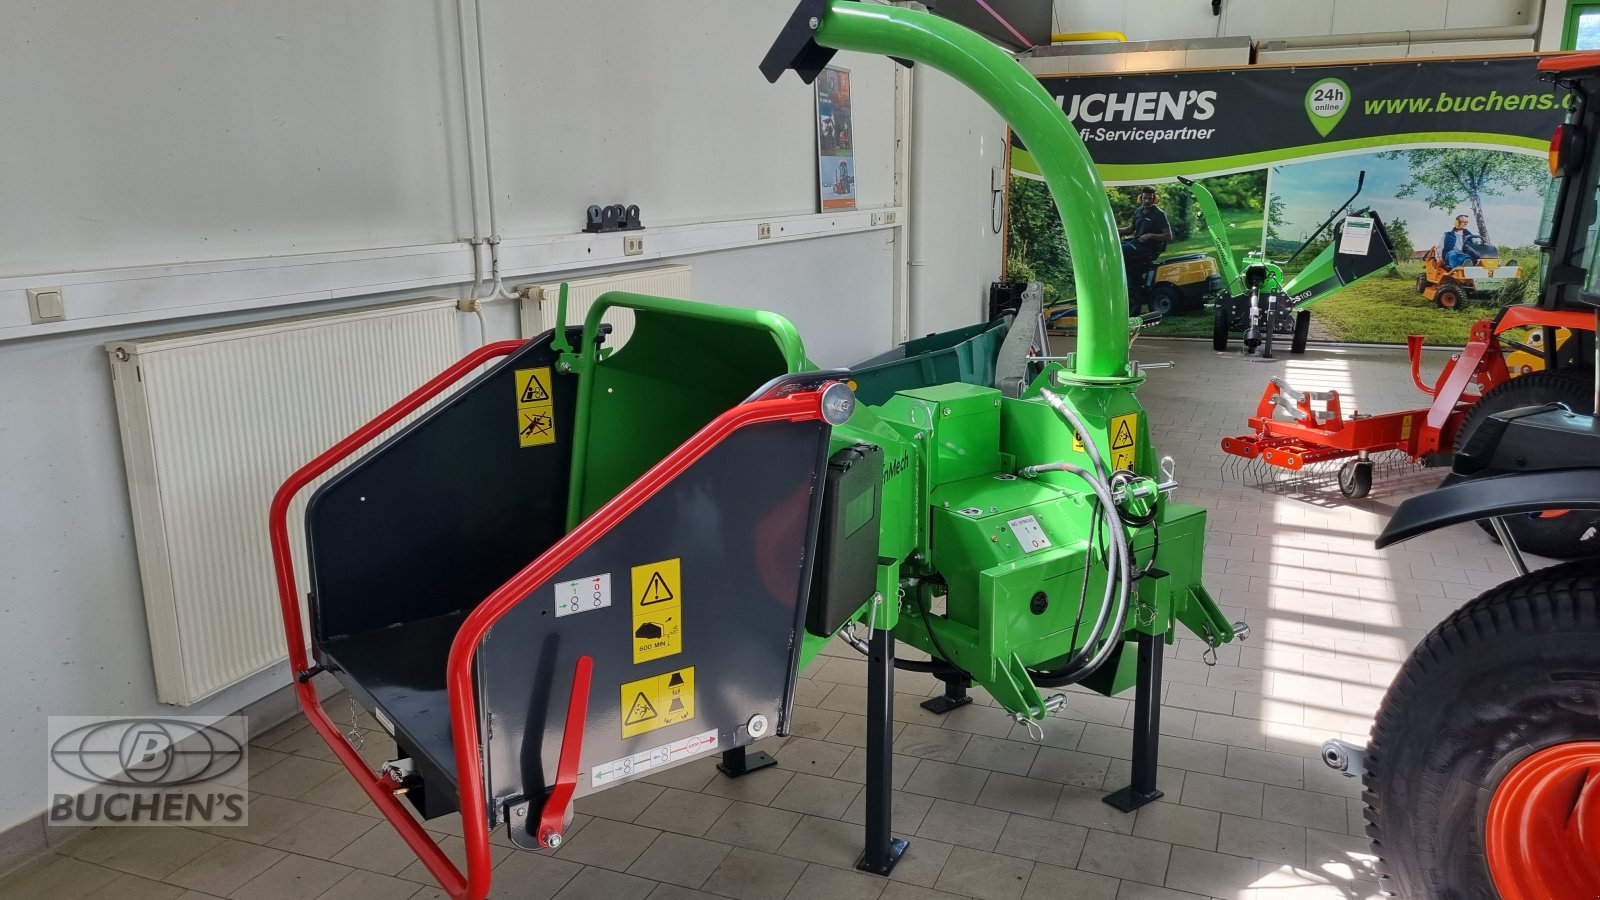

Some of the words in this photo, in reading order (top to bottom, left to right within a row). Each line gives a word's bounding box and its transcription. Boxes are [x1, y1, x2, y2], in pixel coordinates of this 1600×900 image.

[1314, 89, 1344, 102] 24h
[639, 643, 653, 652] 600
[654, 640, 666, 649] MIN
